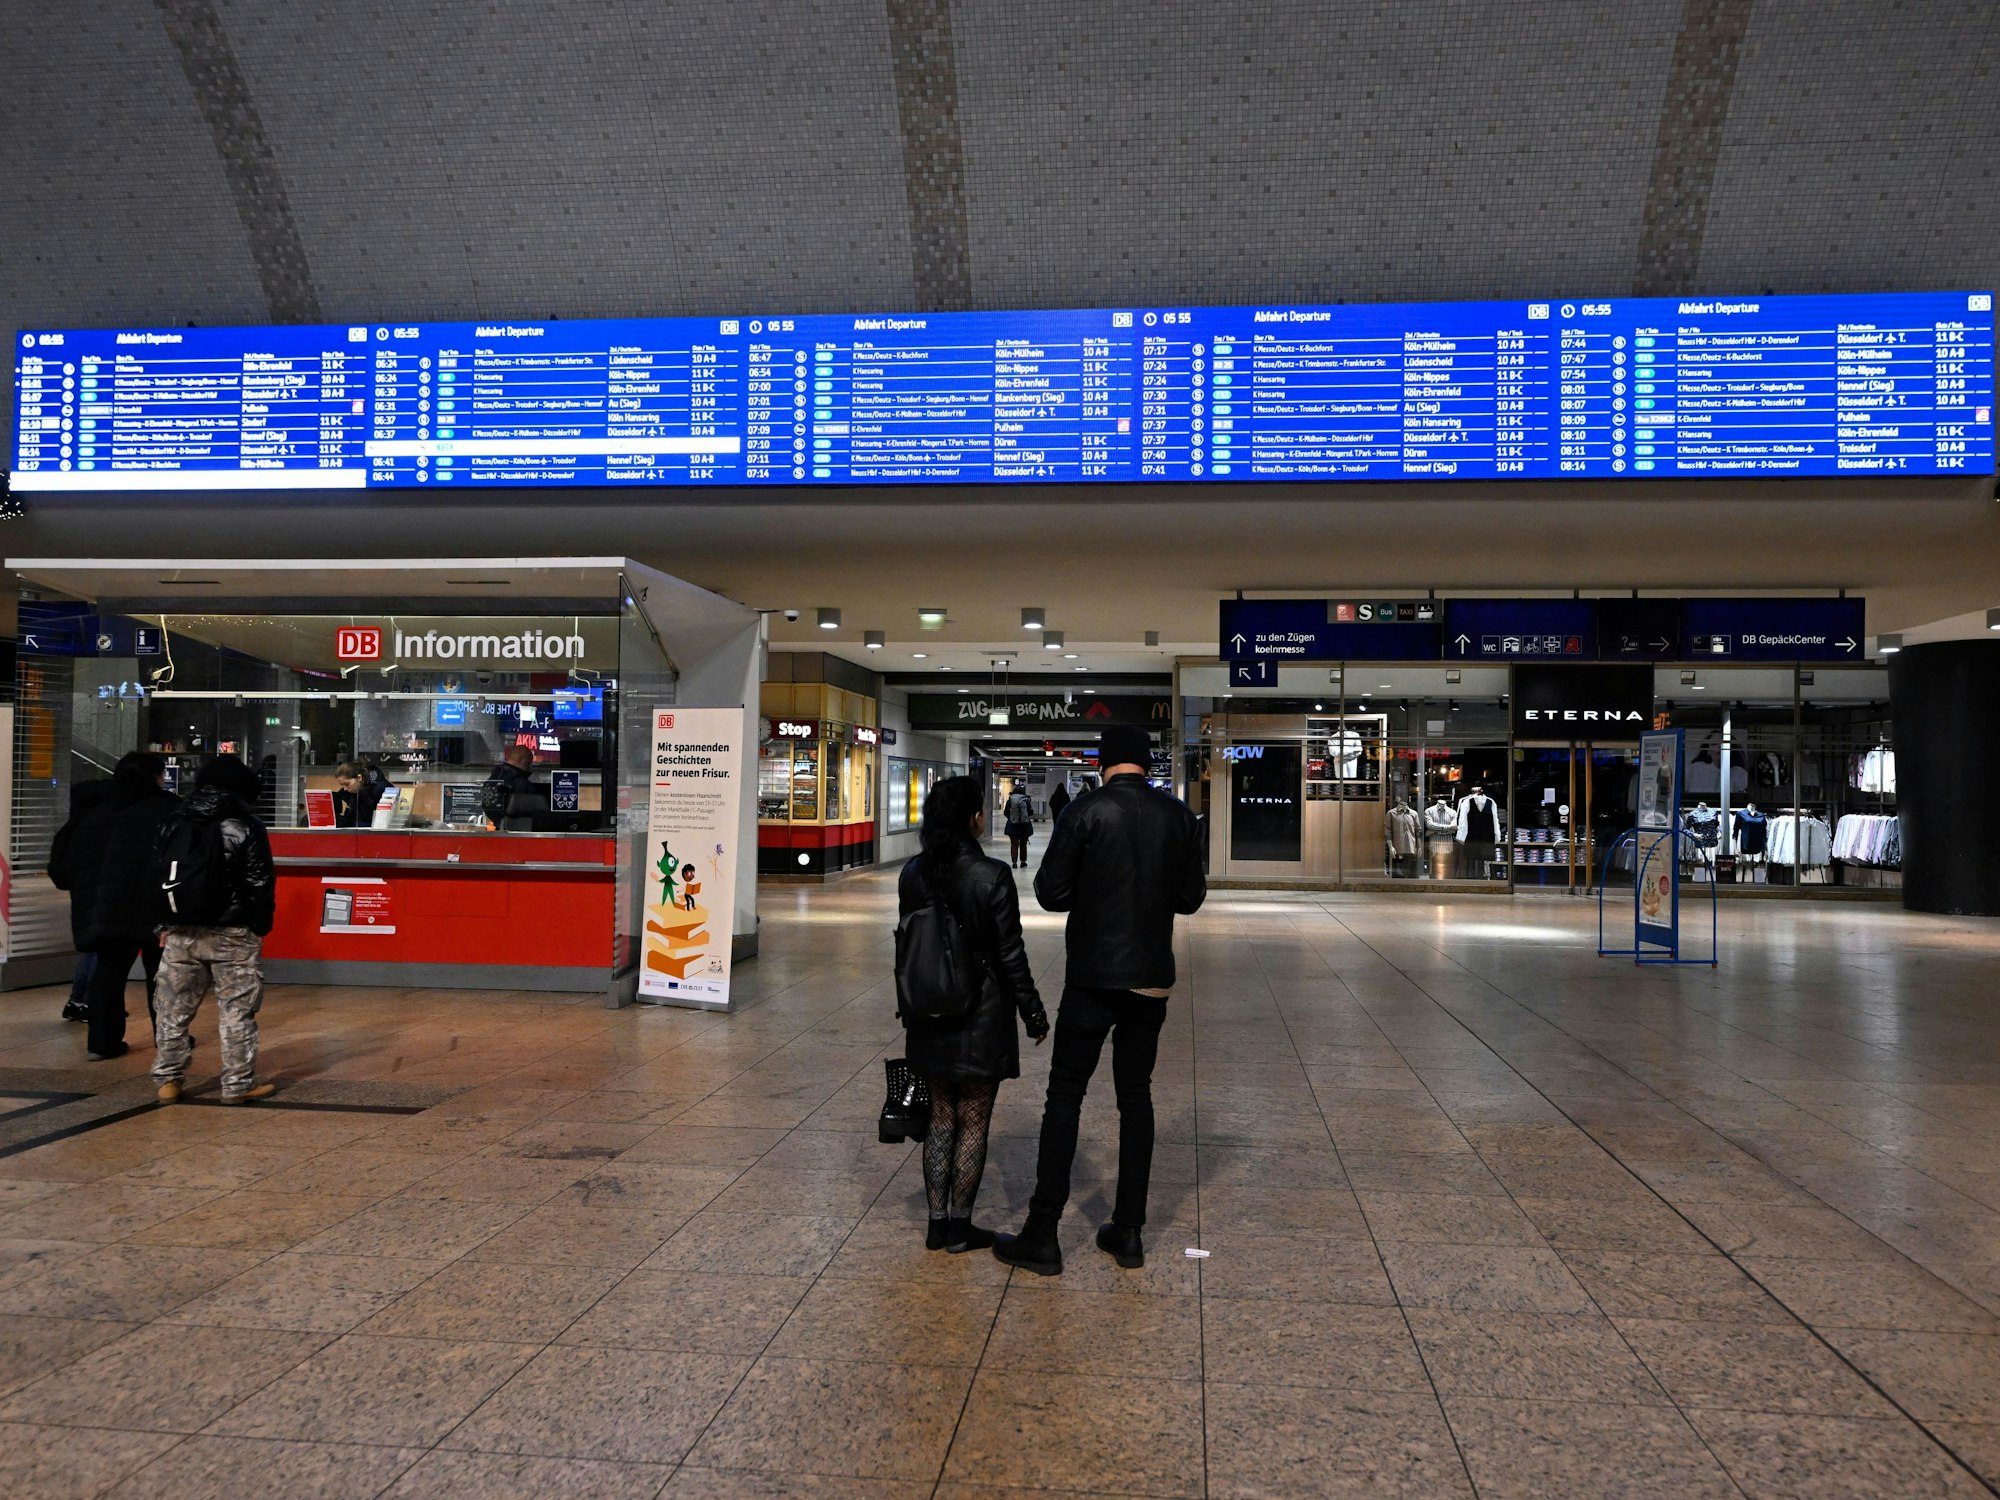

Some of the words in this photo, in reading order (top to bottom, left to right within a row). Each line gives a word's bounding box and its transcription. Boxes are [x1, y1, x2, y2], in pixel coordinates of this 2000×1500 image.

[1531, 307, 1547, 317] DB
[1582, 305, 1611, 315] 05:55
[1678, 303, 1713, 313] Abfahrt
[1716, 303, 1759, 315] Departure
[1116, 315, 1130, 324] DB
[1255, 312, 1287, 322] Abfahrt
[1290, 311, 1331, 322] Departure
[723, 322, 737, 332] DB
[854, 320, 885, 329] Abfahrt
[888, 319, 926, 330] Departure
[394, 328, 419, 338] 05:55
[476, 327, 505, 336] Abfahrt
[507, 327, 544, 337] Departure
[117, 334, 146, 344] Abfahrt
[147, 333, 182, 344] Departure
[1838, 334, 1883, 343] Düsseldorf
[1898, 333, 1906, 342] T.
[1405, 342, 1455, 351] Köln-Mülheim
[1561, 339, 1586, 348] 07:44
[1144, 346, 1167, 355] 07:17
[1838, 350, 1892, 359] Köln-Mülheim
[609, 356, 652, 364] Lüdenscheid
[749, 353, 771, 362] 06:47
[1405, 357, 1452, 366] Lüdenscheid
[1561, 354, 1586, 364] 07:47
[376, 360, 397, 368] 06:24
[1144, 362, 1166, 370] 07:24
[749, 368, 771, 377] 06:54
[996, 364, 1038, 374] Köln-Nippes
[1838, 366, 1886, 376] Köln-Nippes
[376, 374, 397, 382] 06:24
[609, 371, 649, 380] Köln-Nippes
[1404, 373, 1449, 383] Köln-Nippes
[1561, 370, 1585, 379] 07:54
[995, 379, 1049, 387] Köln-Ehrenfeld
[1143, 376, 1166, 385] 07:24
[609, 385, 659, 393] Köln-Ehrenfeld
[749, 382, 771, 391] 07:00
[1561, 385, 1585, 394] 08:01
[1838, 381, 1867, 390] Hennef
[1869, 380, 1894, 391] (Sieg)
[375, 388, 396, 396] 06:30
[1143, 391, 1166, 400] 07:30
[1404, 387, 1461, 396] Köln-Ehrenfeld
[748, 397, 770, 405] 07:01
[995, 394, 1041, 404] Blankenberg
[1042, 392, 1064, 403] (Sieg)
[1838, 396, 1883, 406] Düsseldorf
[1899, 396, 1906, 405] T.
[375, 402, 396, 410] 06:31
[609, 399, 618, 407] Au
[620, 398, 641, 410] (Sieg)
[1404, 403, 1415, 411] Au
[1417, 402, 1440, 413] (Sieg)
[1561, 400, 1585, 409] 08:07
[995, 408, 1035, 417] Düsseldorf
[1049, 407, 1055, 416] T.
[1143, 406, 1166, 415] 07:31
[375, 416, 396, 424] 06:37
[608, 414, 623, 422] Köln
[625, 414, 659, 423] Hansaring
[748, 412, 770, 420] 07:07
[1561, 416, 1586, 424] 08:09
[1838, 412, 1870, 421] Pulheim
[995, 423, 1023, 432] Pulheim
[1143, 421, 1166, 429] 07:37
[1404, 418, 1421, 427] Köln
[1423, 418, 1461, 428] Hansaring
[374, 430, 395, 438] 06:37
[608, 427, 646, 436] Düsseldorf
[748, 426, 770, 434] 07:09
[1838, 428, 1898, 437] Köln-Ehrenfeld
[1143, 436, 1166, 444] 07:37
[1404, 433, 1446, 442] Düsseldorf
[1461, 432, 1468, 441] T.
[1561, 431, 1585, 440] 08:10
[748, 440, 770, 449] 07:10
[995, 438, 1016, 446] Düren
[1561, 446, 1585, 455] 08:11
[1838, 443, 1876, 452] Troisdorf
[994, 452, 1020, 461] Hennef
[1022, 451, 1044, 462] (Sieg)
[1143, 451, 1166, 459] 07:40
[1404, 448, 1427, 457] Düren
[373, 458, 394, 466] 06:41
[607, 456, 632, 464] Hennef
[634, 455, 655, 466] (Sieg)
[747, 455, 769, 463] 07:11
[1838, 459, 1883, 468] Düsseldorf
[1899, 458, 1906, 467] T.
[1142, 466, 1165, 474] 07:41
[1404, 464, 1431, 472] Hennef
[1433, 463, 1456, 474] (Sieg)
[1561, 462, 1585, 470] 08:14
[607, 470, 645, 479] Düsseldorf
[747, 469, 769, 477] 07:14
[994, 467, 1034, 476] Düsseldorf
[1049, 466, 1054, 475] T.
[373, 472, 394, 480] 06:44
[1359, 604, 1372, 620] S
[1287, 633, 1315, 644] Zügen
[1742, 635, 1756, 644] DB
[1759, 635, 1826, 645] GepäckCenter
[342, 632, 377, 655] DB
[395, 630, 585, 658] Information
[1255, 645, 1305, 653] koelnmesse
[1258, 662, 1266, 679] 1
[958, 701, 988, 718] ZUG
[1525, 710, 1643, 720] ETERNA
[661, 717, 672, 726] DB
[779, 723, 811, 738] Stop
[657, 742, 672, 751] Mit
[674, 743, 729, 753] spannenden
[657, 755, 711, 765] Geschichten
[656, 769, 670, 777] zur
[702, 769, 730, 778] Frisur.
